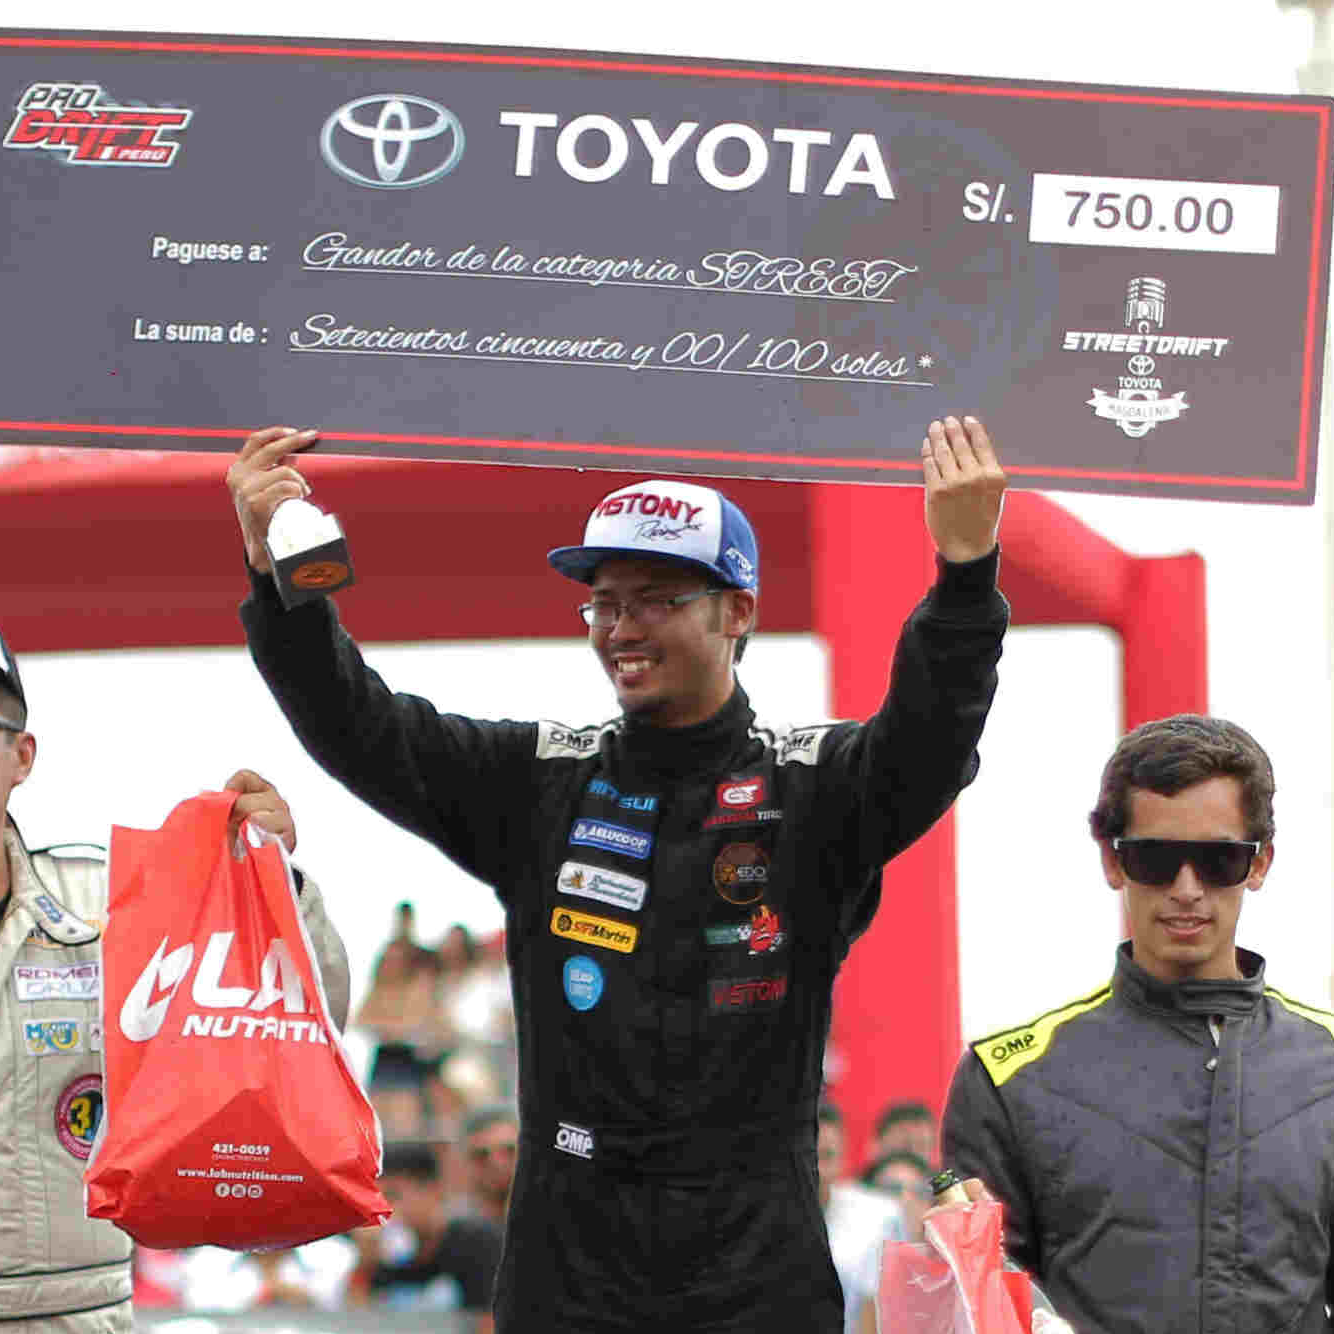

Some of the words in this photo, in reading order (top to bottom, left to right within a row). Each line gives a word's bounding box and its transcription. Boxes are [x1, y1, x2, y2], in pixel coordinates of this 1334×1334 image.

[25, 86, 97, 109] PRO
[10, 109, 187, 160] DRIFT
[499, 111, 896, 200] TOYOTA
[962, 181, 1014, 223] S/.
[1064, 190, 1234, 235] 750.00
[152, 236, 244, 264] Paguese
[248, 242, 269, 262] a:
[303, 231, 438, 271] Gandor
[446, 244, 487, 272] de
[491, 246, 527, 274] la
[532, 252, 683, 287] categoria
[686, 250, 918, 299] STREET
[133, 317, 160, 341] La
[165, 323, 223, 343] suma
[228, 321, 256, 343] de
[289, 313, 471, 353] Setecientos
[475, 330, 627, 361] cincuenta
[630, 343, 656, 371] y
[831, 349, 910, 378] soles
[1062, 331, 1229, 357] STREETDRIFT
[1117, 376, 1163, 390] TOYOTA
[192, 931, 315, 1014] LA
[990, 1034, 1036, 1062] OMP
[555, 1128, 594, 1155] OMP
